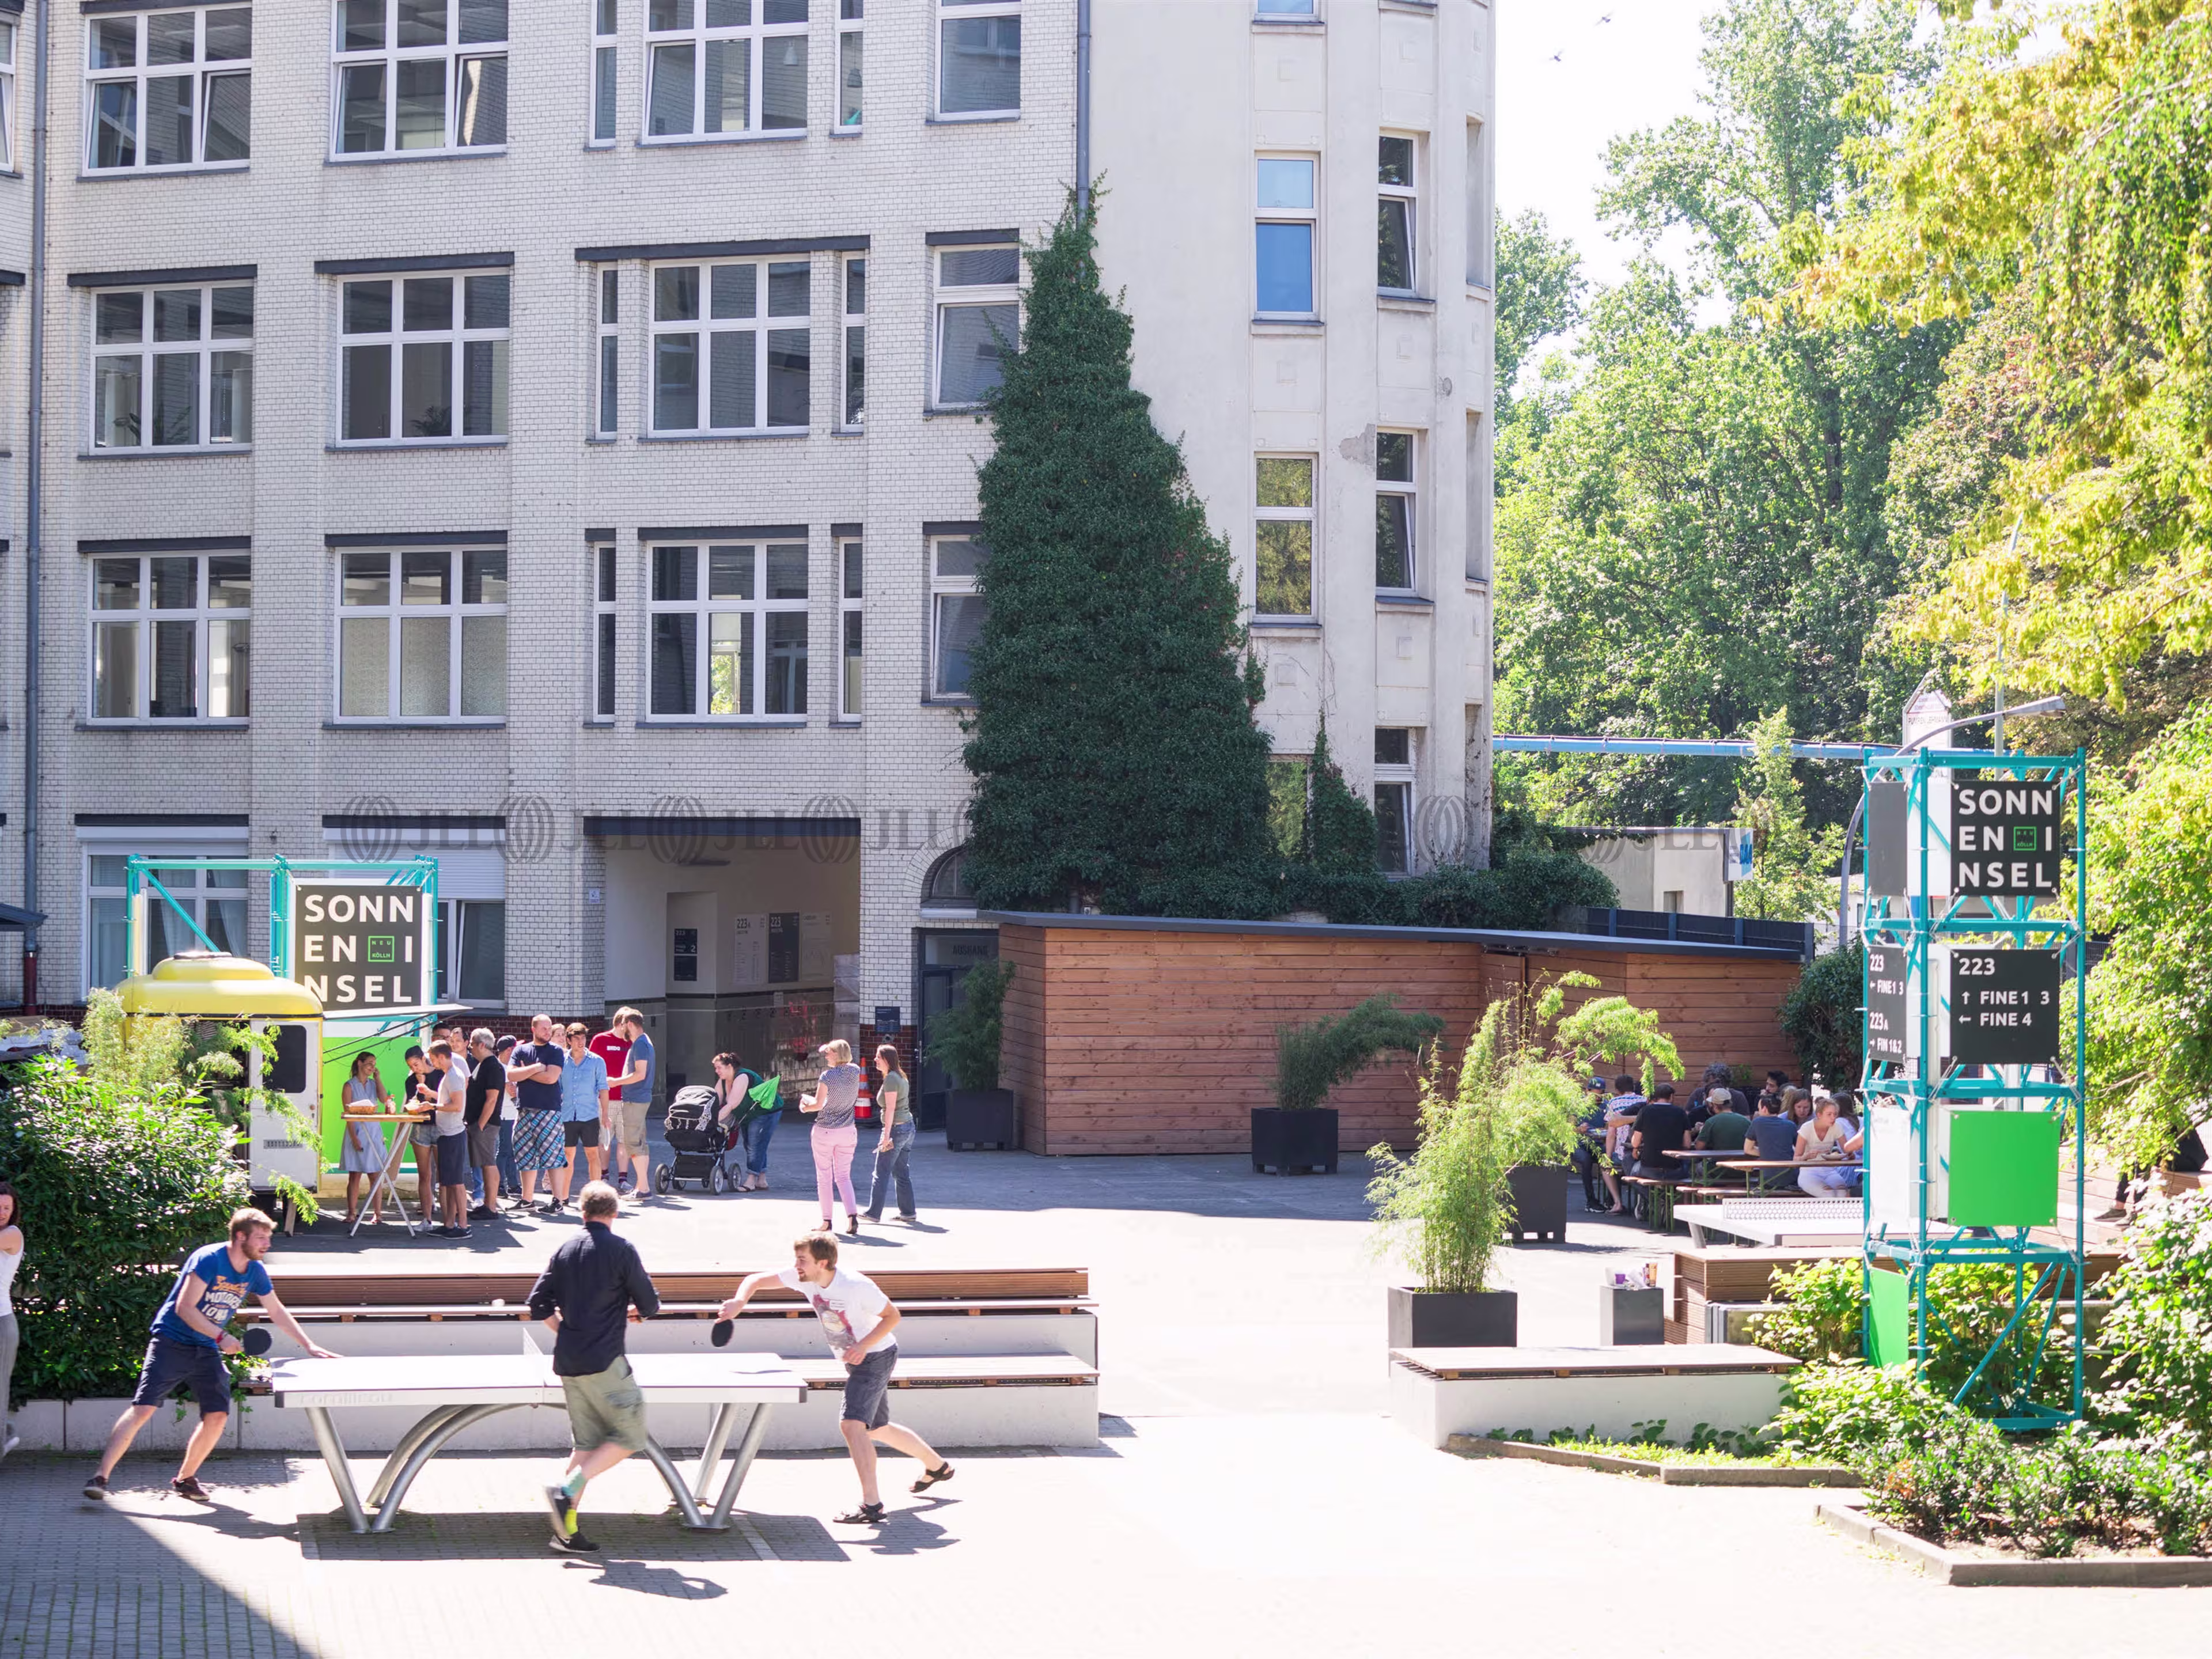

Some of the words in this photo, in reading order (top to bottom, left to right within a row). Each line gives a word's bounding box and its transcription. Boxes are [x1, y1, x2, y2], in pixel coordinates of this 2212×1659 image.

[1959, 789, 2052, 815] SONN
[1959, 826, 2004, 851] EN
[1959, 862, 2052, 888] NSEL
[304, 895, 414, 923] SONN
[304, 935, 357, 962] EN
[1870, 954, 1884, 972] 223
[1959, 957, 1995, 975] 223
[304, 975, 412, 1003] NSEL
[1877, 979, 1892, 994] FINE
[1899, 981, 1904, 996] 3
[1980, 991, 2018, 1005] FINE
[2021, 991, 2028, 1005] 1
[2040, 990, 2050, 1005] 3
[1980, 1012, 2018, 1027] FINE
[2022, 1012, 2032, 1027] 4
[1877, 1037, 1888, 1052] FIN
